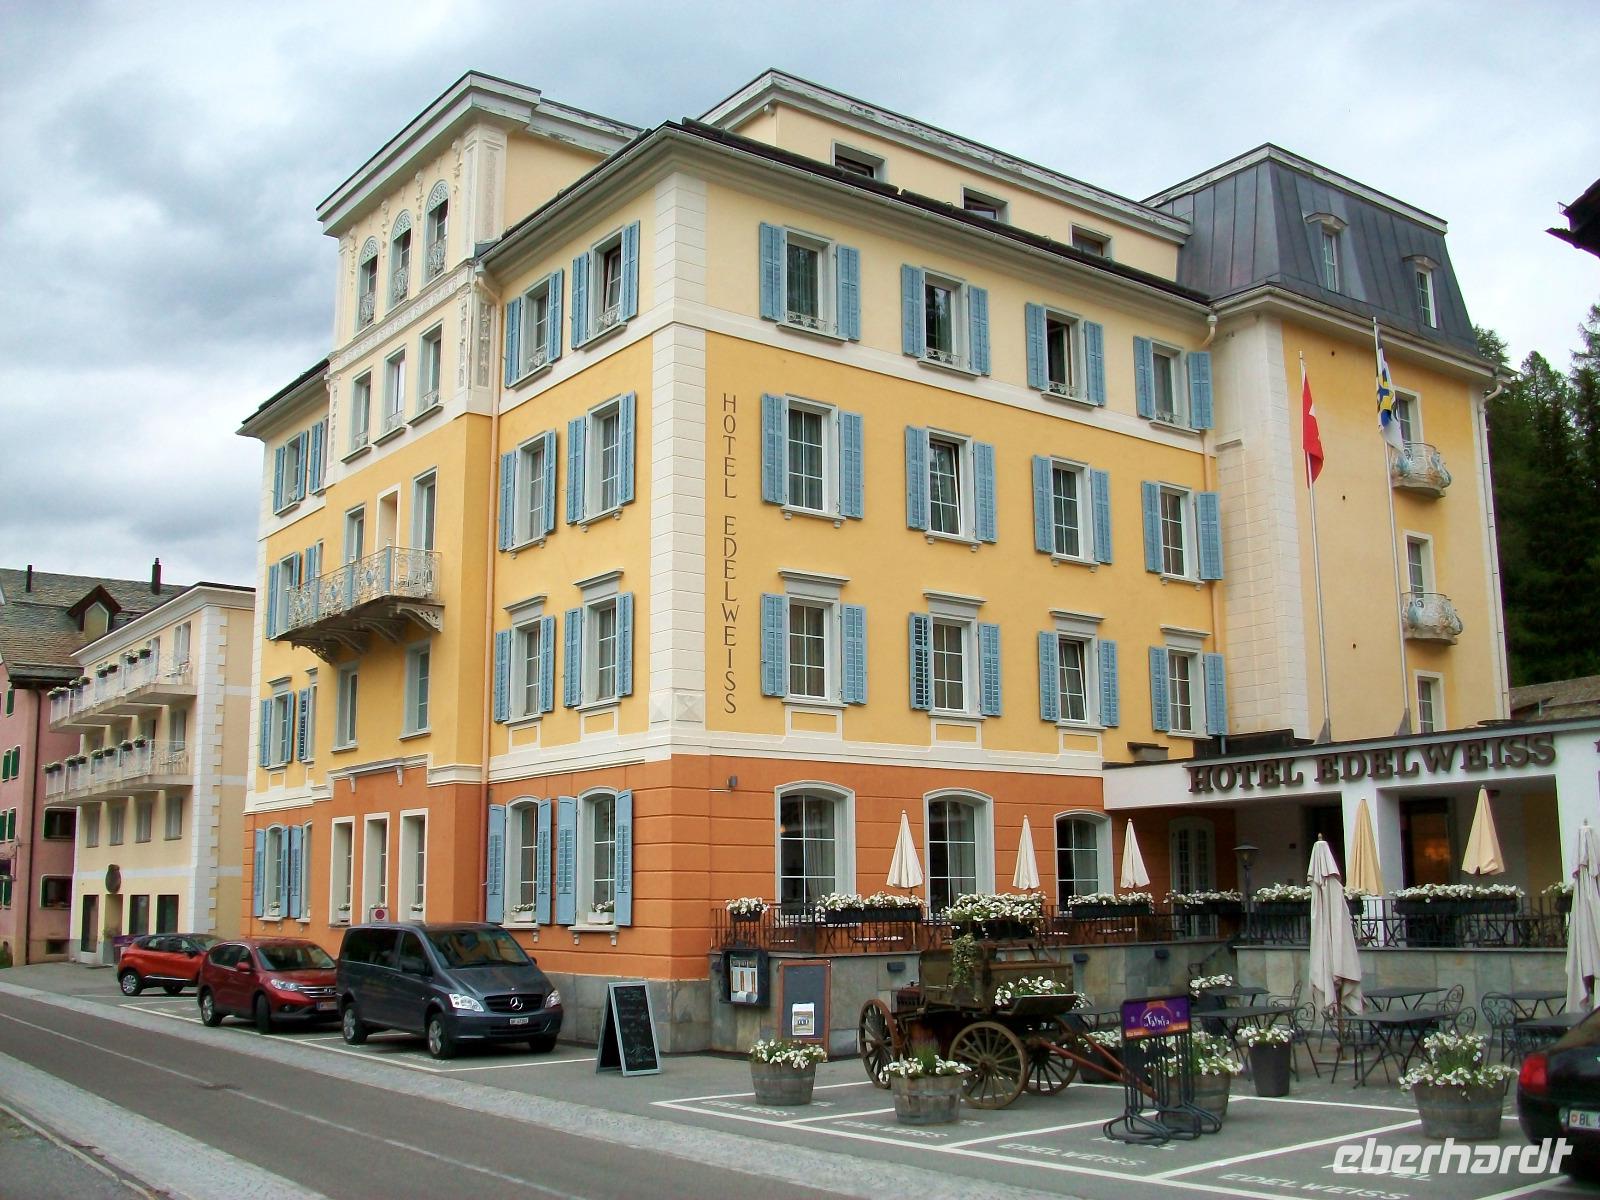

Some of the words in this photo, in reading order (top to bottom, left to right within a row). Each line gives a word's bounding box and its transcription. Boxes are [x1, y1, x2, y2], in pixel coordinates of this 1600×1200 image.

[722, 392, 737, 499] HOTEL
[721, 515, 740, 714] EDELWEISS
[1187, 757, 1304, 793] HOTEL
[1314, 732, 1556, 784] EDELWEISS
[1218, 1173, 1409, 1200] EDELWEISS
